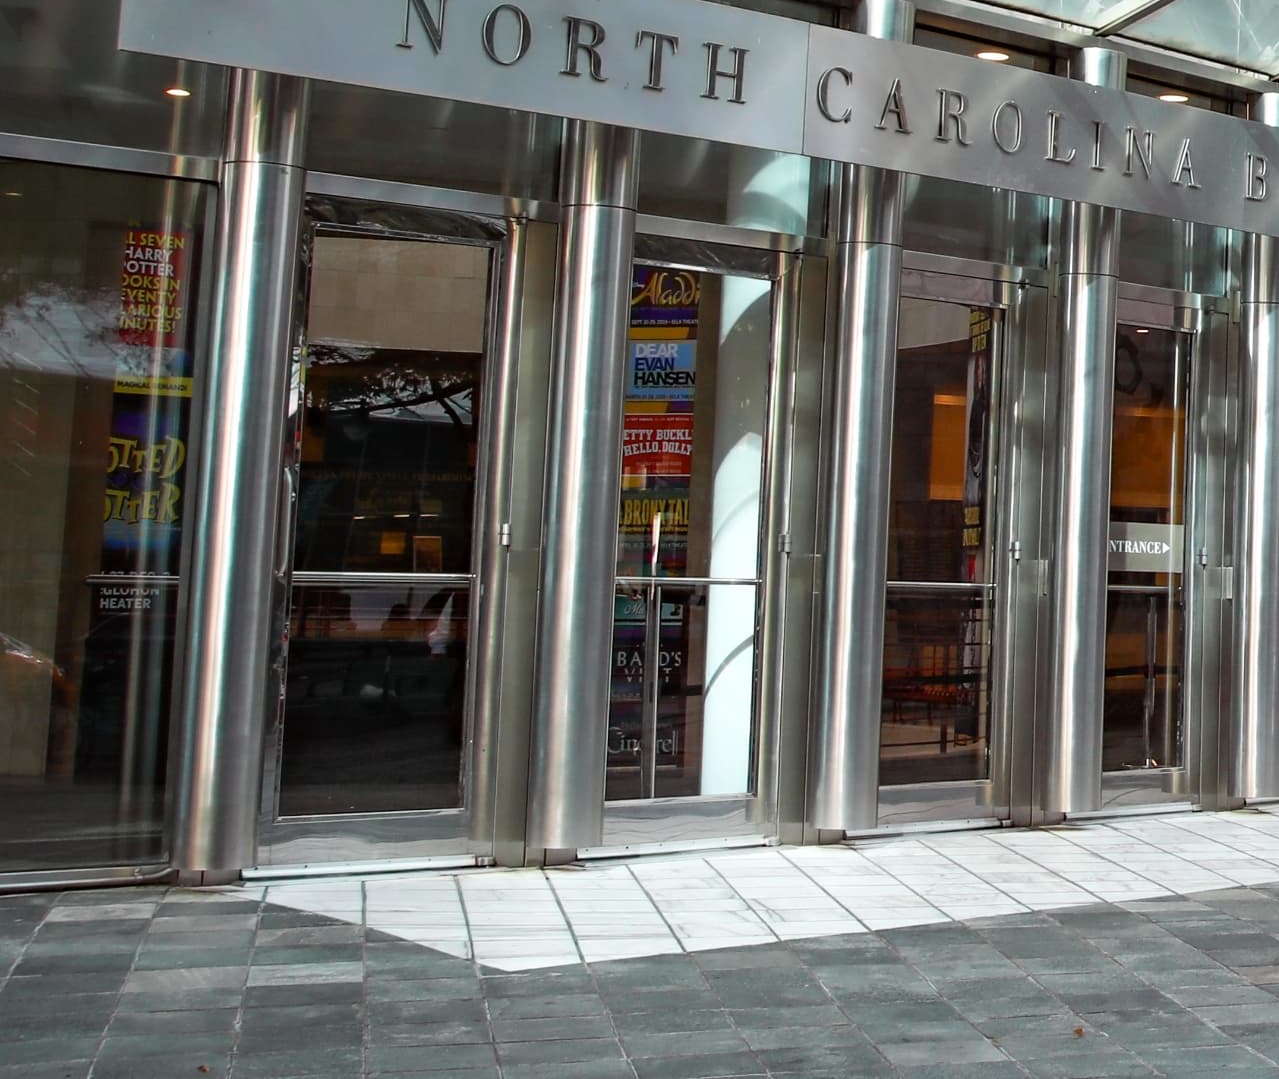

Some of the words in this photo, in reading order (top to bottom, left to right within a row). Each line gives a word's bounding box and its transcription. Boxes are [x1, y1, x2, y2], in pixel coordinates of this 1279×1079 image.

[816, 66, 1201, 189] CAROLINA
[140, 233, 185, 249] SEVEN
[125, 246, 173, 263] HARRY
[123, 261, 174, 277] OTTER
[122, 275, 161, 289] OOKS
[631, 271, 700, 305] Aladdi
[120, 288, 176, 304] EVENTY
[120, 304, 183, 320] LARIOUS
[119, 316, 176, 333] INUTES!
[636, 344, 679, 358] DEAR
[634, 357, 675, 371] EVAN
[633, 371, 697, 386] HANSEN
[623, 429, 654, 440] ETTY
[656, 429, 692, 440] BUCKL
[107, 435, 186, 479] OTTED
[104, 482, 180, 525] OTTER
[668, 498, 689, 525] TAL
[1109, 540, 1161, 554] NTRANCE
[100, 598, 151, 609] HEATER
[616, 651, 682, 667] BAD'S
